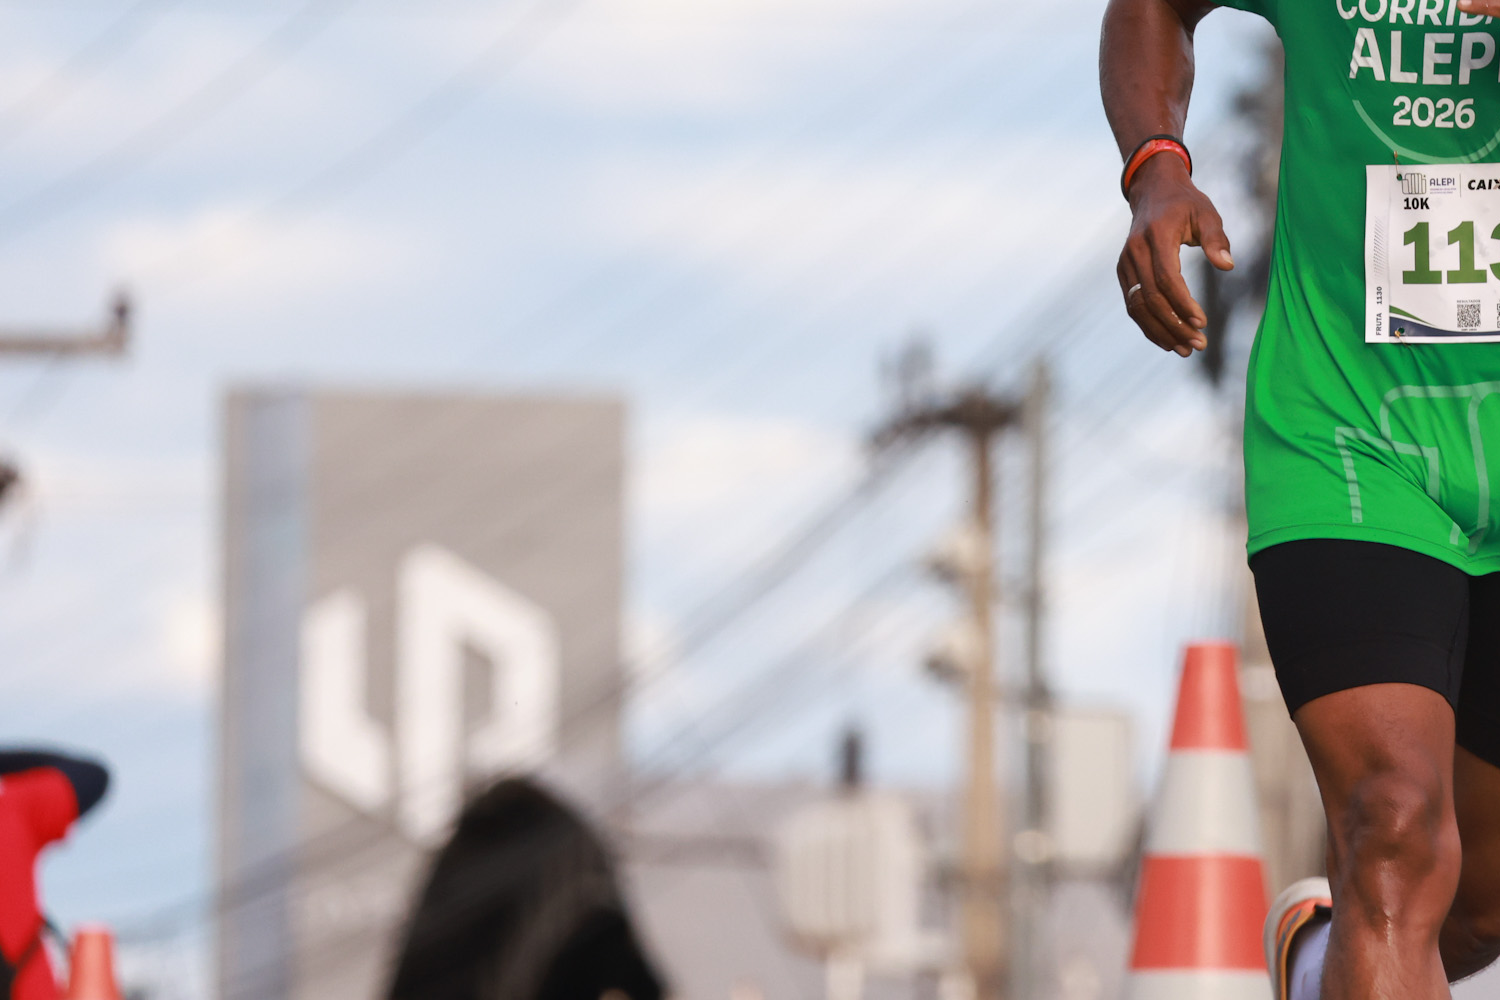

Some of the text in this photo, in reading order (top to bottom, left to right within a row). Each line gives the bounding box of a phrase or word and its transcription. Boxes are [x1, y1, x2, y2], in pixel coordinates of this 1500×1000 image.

[1392, 95, 1476, 129] 2026
[1429, 177, 1455, 186] ALEPI
[1403, 197, 1430, 210] 10K
